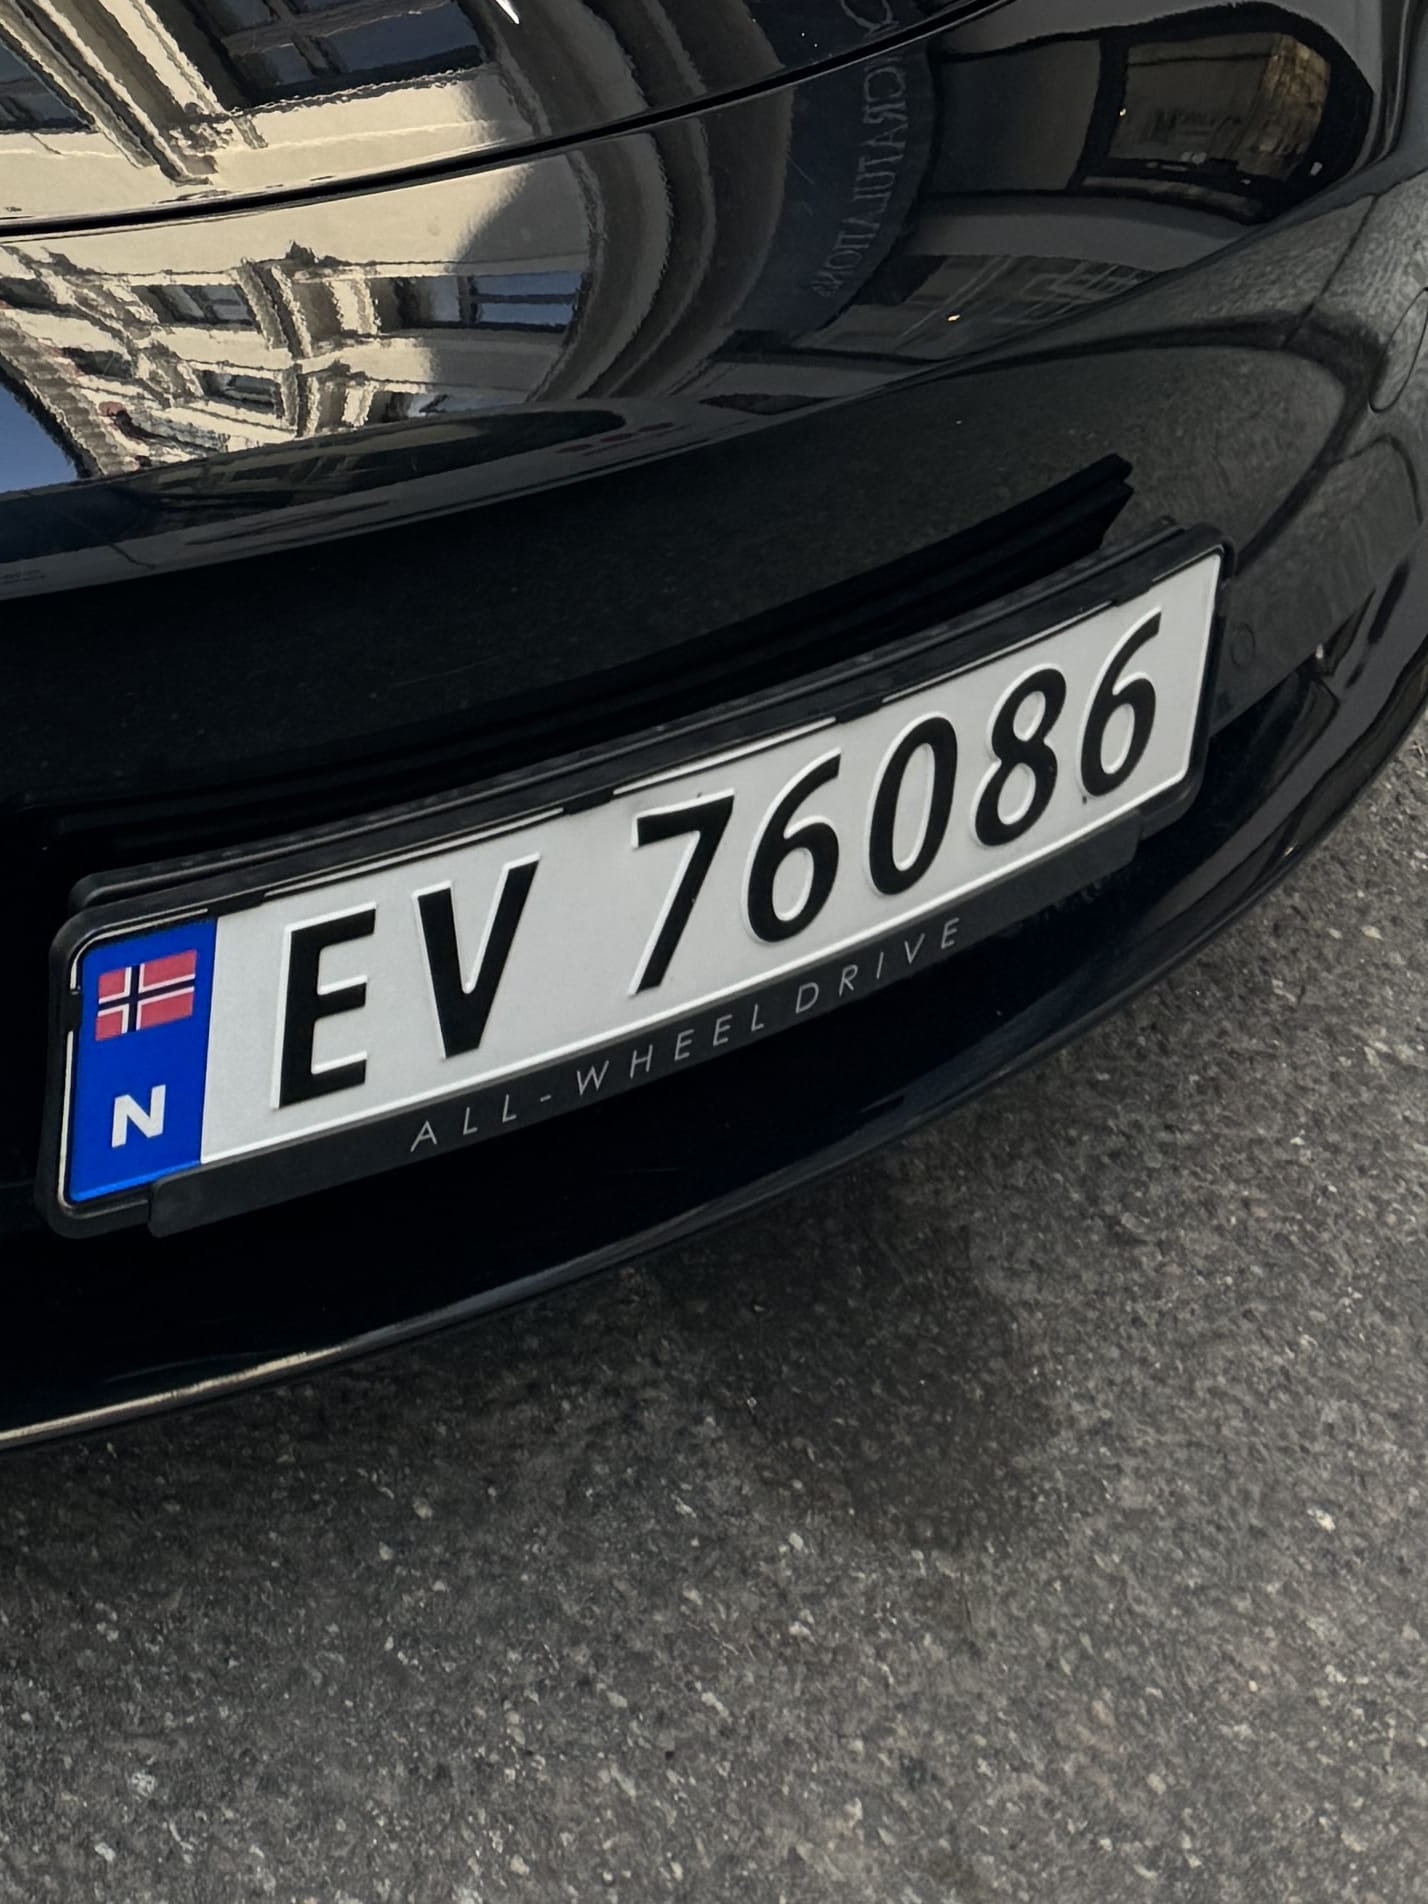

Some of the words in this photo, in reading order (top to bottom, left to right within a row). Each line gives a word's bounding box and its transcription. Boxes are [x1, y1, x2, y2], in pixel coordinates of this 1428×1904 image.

[278, 859, 537, 1106] EV
[634, 611, 1161, 994] 76086
[795, 916, 960, 1015] DRIVE
[112, 1087, 164, 1148] N
